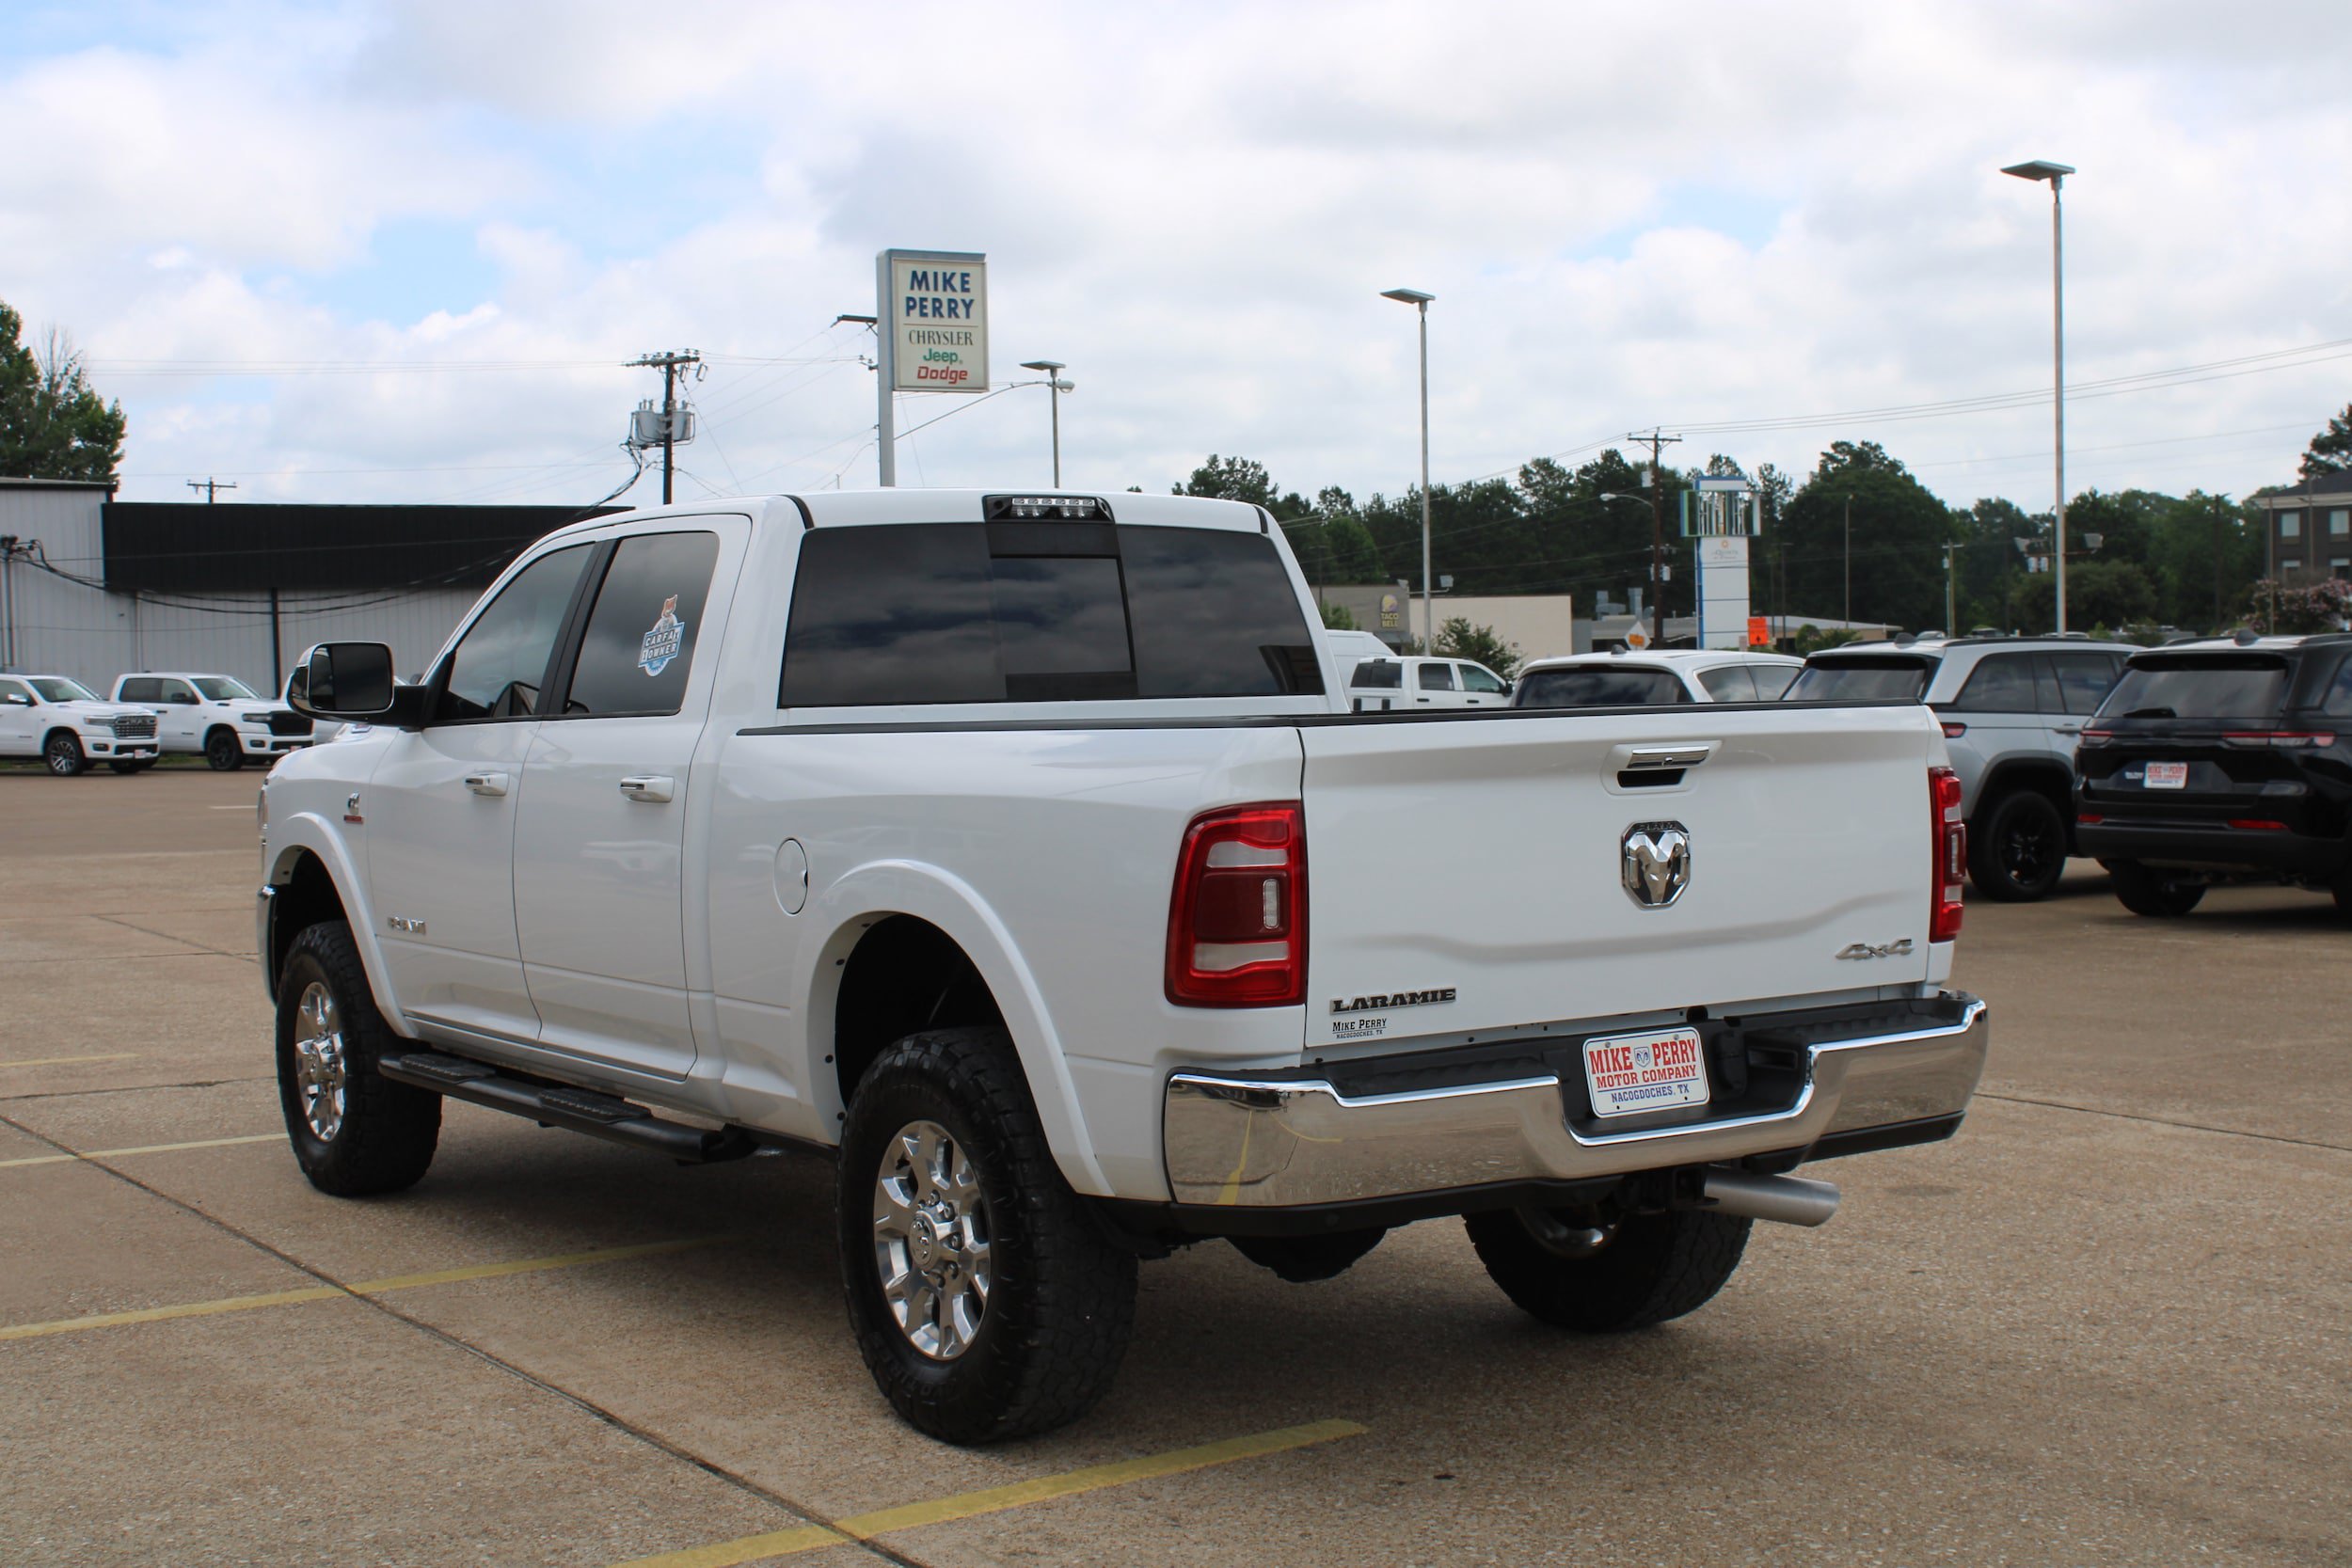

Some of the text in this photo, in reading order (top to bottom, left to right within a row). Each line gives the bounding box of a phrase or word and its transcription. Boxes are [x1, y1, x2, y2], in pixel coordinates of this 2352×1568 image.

[910, 270, 971, 293] MIKE
[905, 296, 975, 319] PERRY
[909, 329, 974, 346] CHRYSLER
[923, 348, 959, 365] Jeep
[917, 366, 968, 385] Dodge
[1330, 988, 1456, 1015] LARAMIE
[1588, 1037, 1696, 1074] MIKE PERRY
[1597, 1065, 1696, 1088] MOTOR COMPANY
[1677, 1084, 1690, 1094] TX
